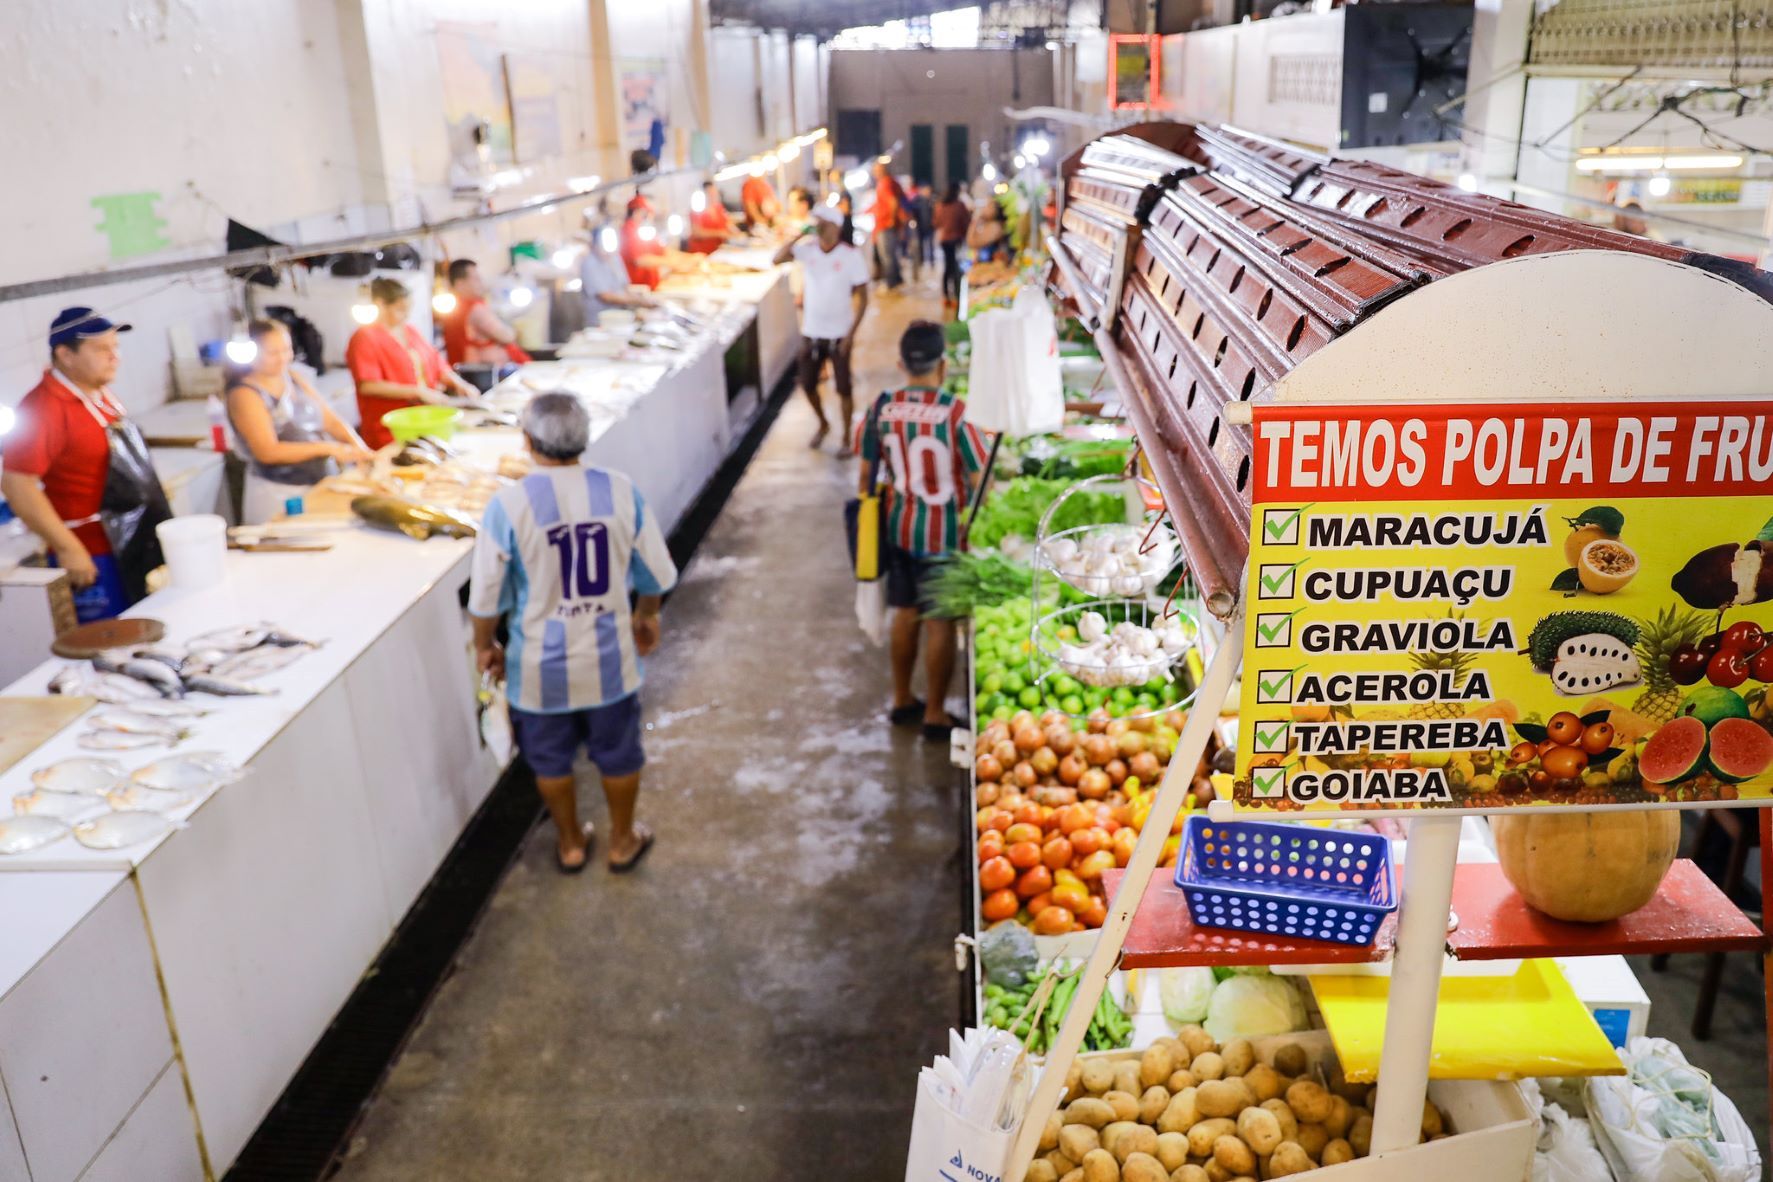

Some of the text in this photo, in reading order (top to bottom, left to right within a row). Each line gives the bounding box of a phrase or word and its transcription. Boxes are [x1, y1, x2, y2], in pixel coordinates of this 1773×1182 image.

[883, 433, 954, 505] 10
[1261, 419, 1427, 487] TEMOS
[1442, 417, 1593, 486] POLPA
[1610, 416, 1677, 483] DE
[1309, 507, 1547, 547] MARACUJÁ
[547, 521, 609, 600] 10
[1305, 569, 1511, 605] CUPUAÇU
[1301, 621, 1514, 652] GRAVIOLA
[1296, 672, 1490, 703] ACEROLA
[1295, 722, 1506, 752] TAPEREBA
[1291, 769, 1447, 800] GOIABA
